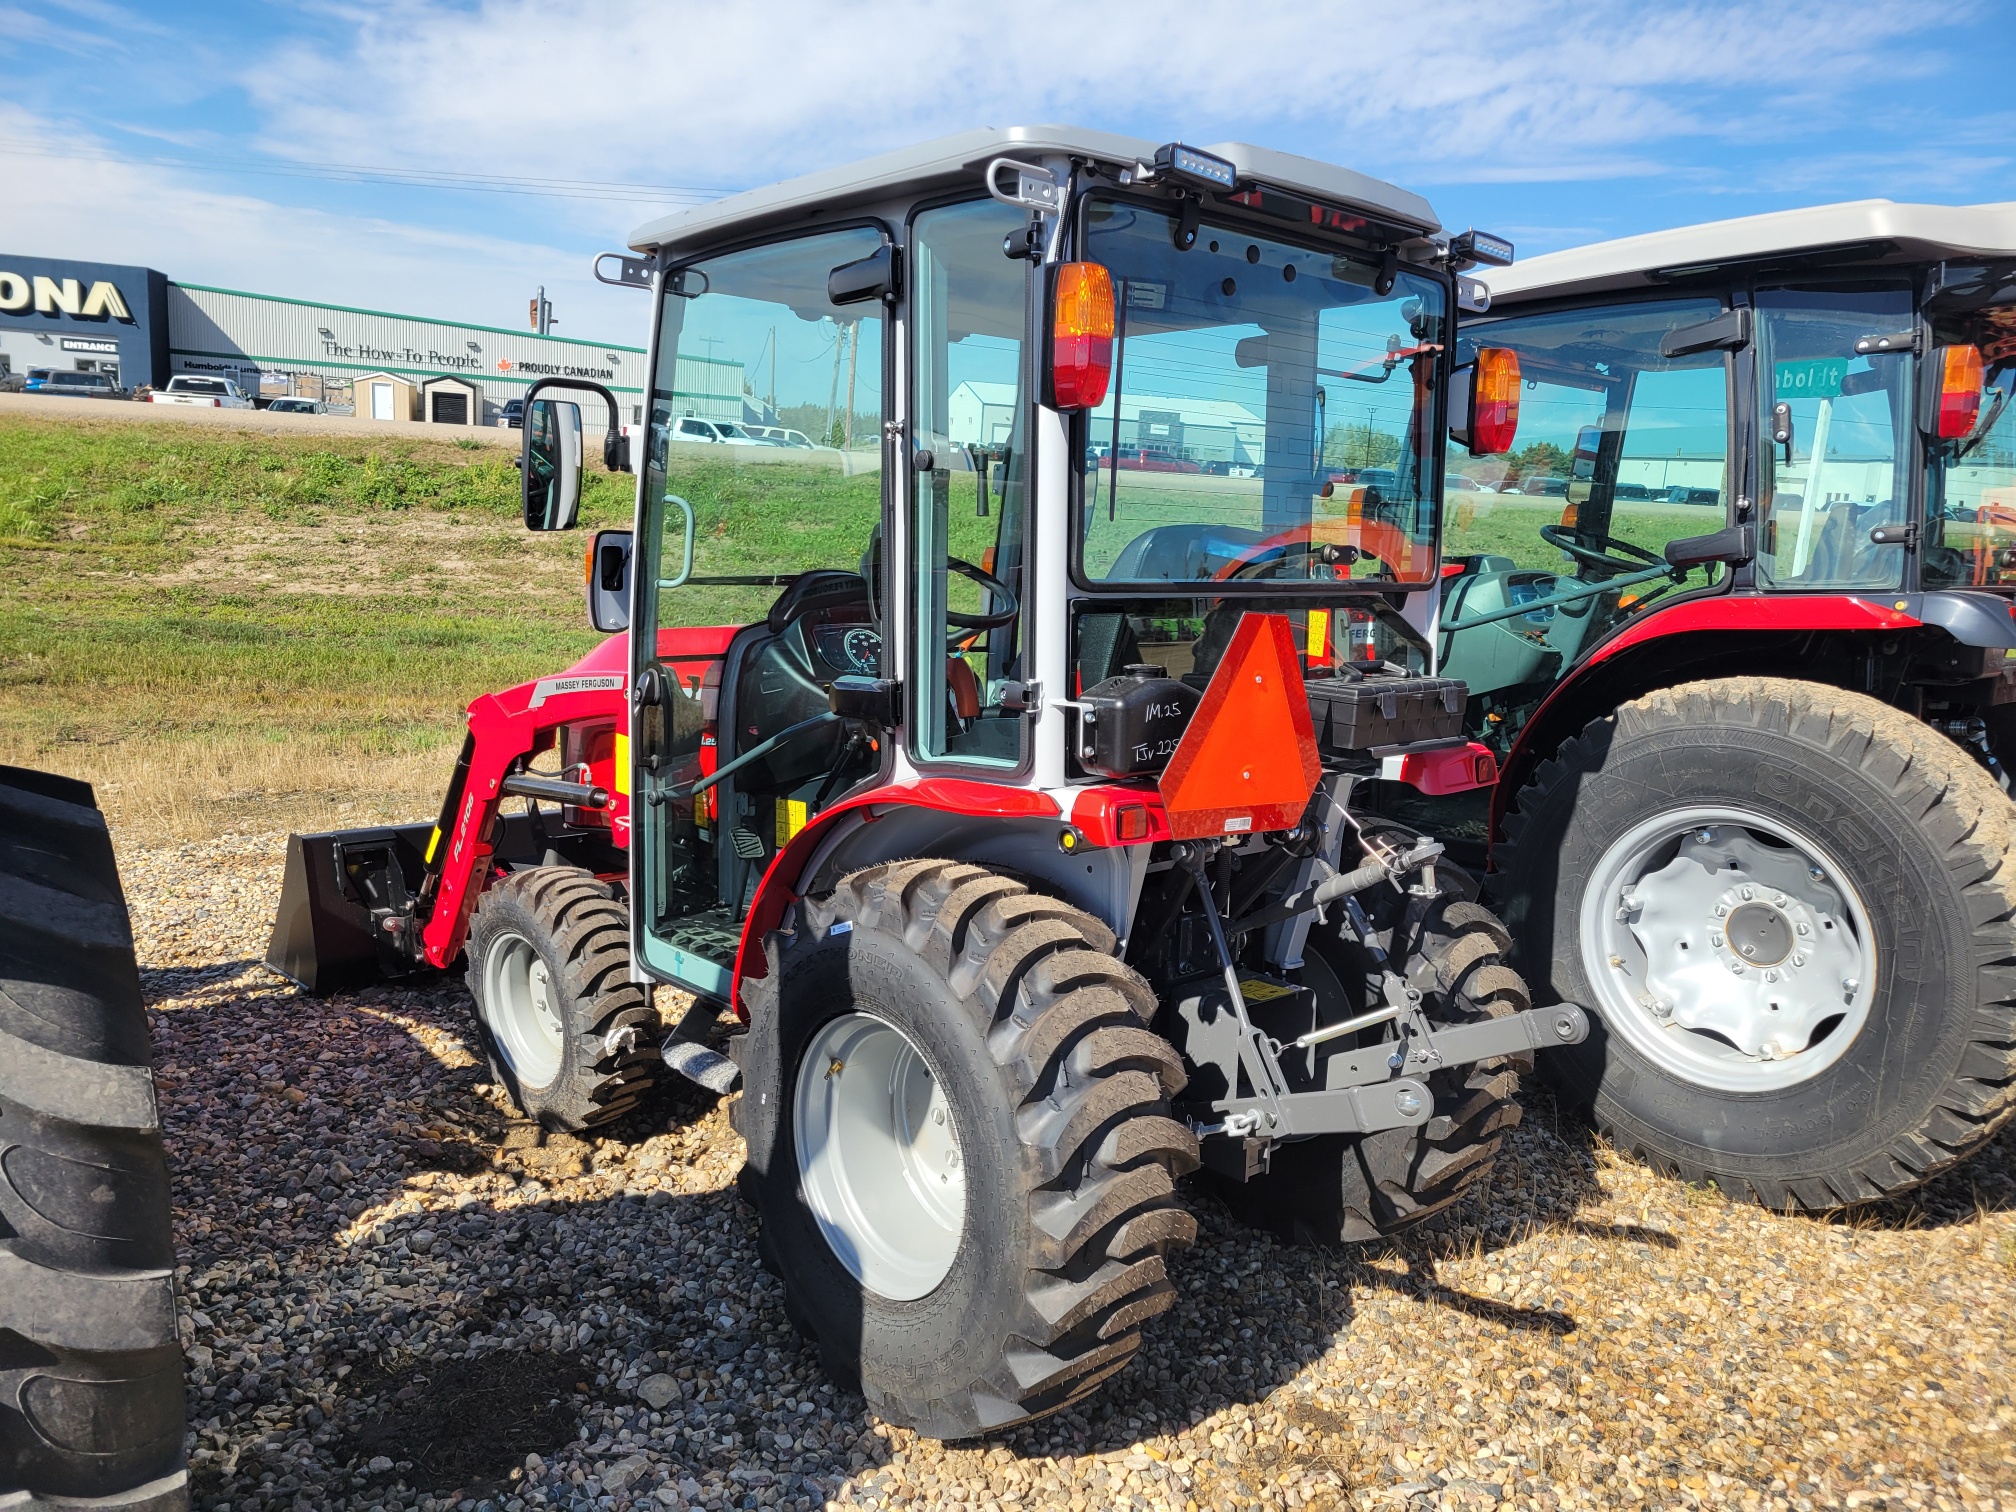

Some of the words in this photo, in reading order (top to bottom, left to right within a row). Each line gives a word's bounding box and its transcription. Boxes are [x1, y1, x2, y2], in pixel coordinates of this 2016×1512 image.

[63, 340, 117, 352] ENTRANCE
[322, 340, 352, 357] The
[519, 361, 560, 375] PROUDLY
[564, 365, 613, 379] CANADIAN
[555, 680, 580, 691] MASSEY
[581, 678, 615, 689] FERGUSON
